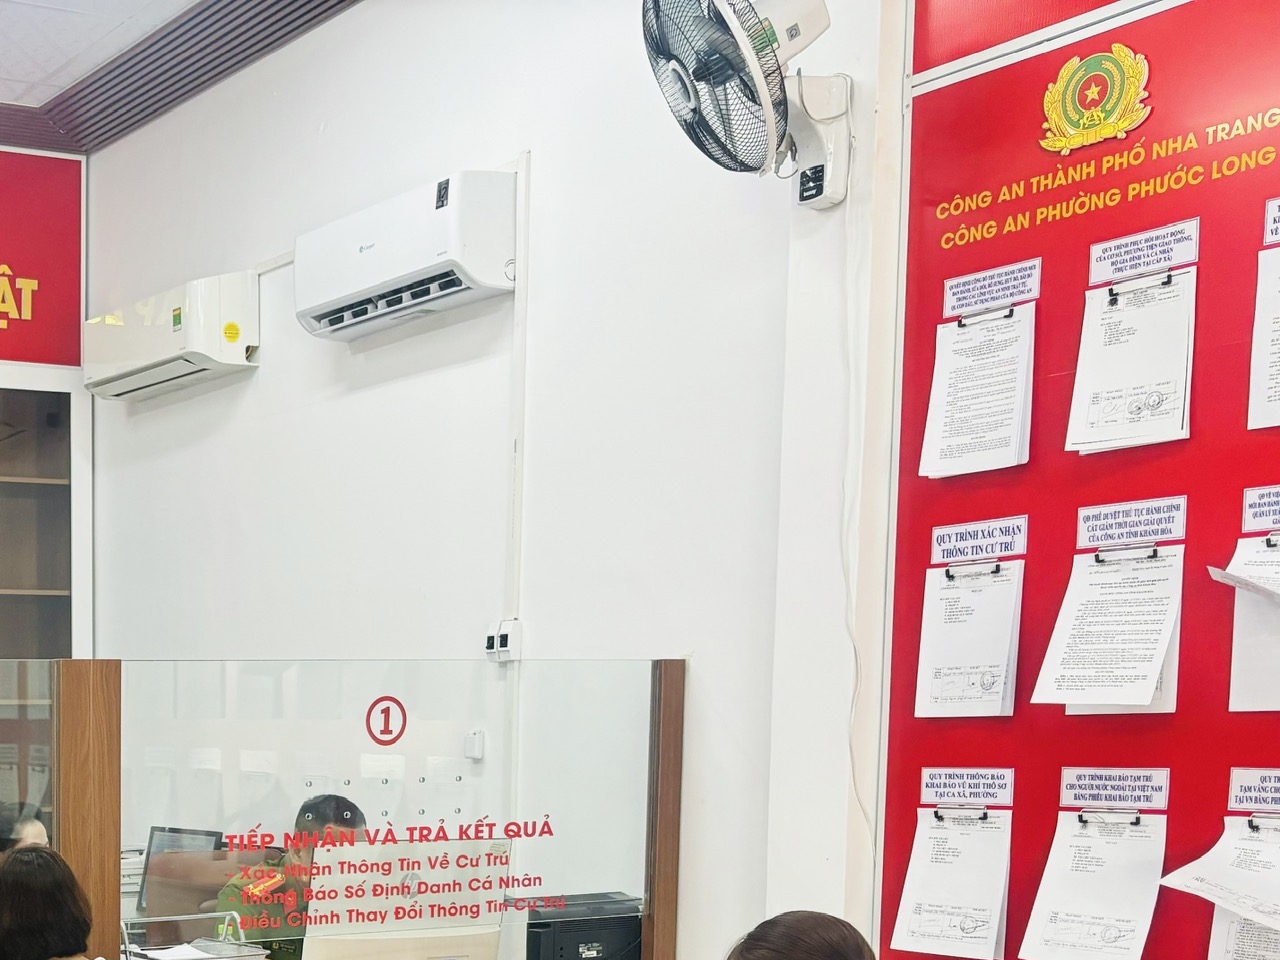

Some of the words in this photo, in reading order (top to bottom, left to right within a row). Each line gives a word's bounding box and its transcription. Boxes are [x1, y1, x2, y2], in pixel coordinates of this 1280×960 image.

[936, 189, 992, 220] CÔNG
[997, 180, 1024, 201] AN
[1029, 160, 1095, 192] THÀNH
[1102, 137, 1146, 175] PHỐ
[1152, 132, 1198, 161] NHA
[1205, 107, 1280, 145] TRANG
[939, 220, 996, 249] CÔNG
[1002, 210, 1030, 232] AN
[1036, 189, 1121, 225] PHƯỜNG
[1127, 162, 1204, 201] PHƯỚC
[1211, 147, 1276, 181] LONG
[937, 533, 953, 546] QUY
[955, 529, 978, 542] TRÌNH
[980, 526, 997, 539] XÁC
[999, 524, 1022, 540] NHẬN
[941, 545, 968, 559] THÔNG
[970, 544, 984, 555] TIN
[985, 542, 998, 554] CƯ
[379, 706, 393, 735] 1
[944, 772, 964, 780] TRÌNH
[966, 772, 989, 780] THÔNG
[991, 772, 1005, 780] BÁO
[935, 791, 945, 800] TẠI
[957, 790, 967, 798] XÃ,
[225, 823, 274, 851] TIẾP
[284, 826, 355, 852] NHẬN
[364, 821, 398, 846] VÀ
[406, 819, 448, 843] TRẢ
[459, 816, 496, 840] KẾT
[504, 814, 554, 839] QUẢ
[241, 860, 277, 879] Xác
[284, 859, 331, 881] Nhận
[338, 857, 391, 877] Thông
[398, 856, 421, 872] Tin
[428, 852, 449, 870] Về
[459, 852, 482, 868] Cư
[485, 850, 509, 866] Trú
[241, 888, 297, 908] Thông
[303, 884, 338, 901] Báo
[344, 878, 366, 898] Số
[372, 882, 410, 900] Định
[418, 879, 462, 894] Danh
[469, 874, 493, 891] Cá
[498, 873, 542, 889] Nhân
[239, 911, 279, 930] Điều
[287, 909, 339, 928] Chỉnh
[347, 908, 388, 928] Thay
[394, 902, 422, 920] Đổi
[429, 902, 480, 919] Thông
[487, 898, 508, 913] Tin
[513, 896, 538, 911] Cư
[542, 894, 565, 909] Trú
